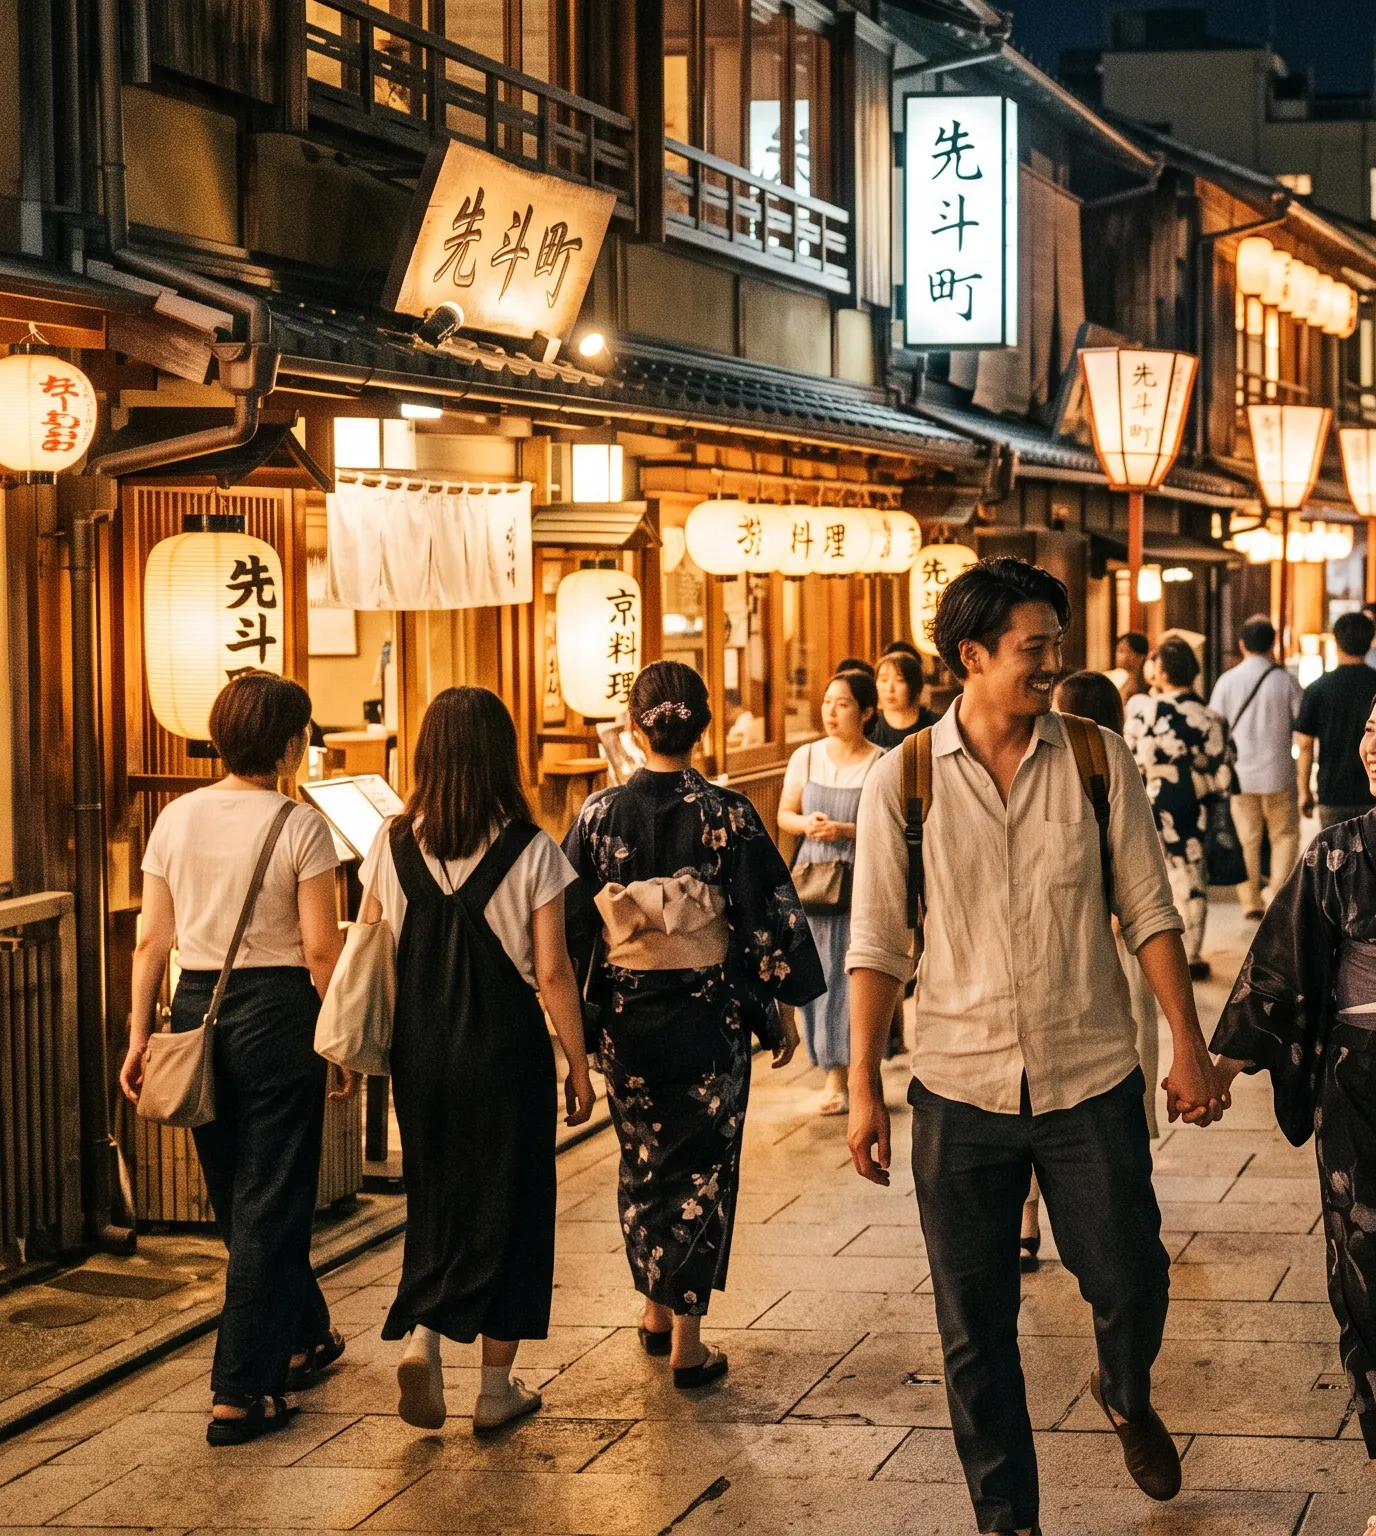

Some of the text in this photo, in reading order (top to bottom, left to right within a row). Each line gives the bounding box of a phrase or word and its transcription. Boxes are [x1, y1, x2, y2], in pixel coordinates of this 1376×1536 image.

[433, 186, 583, 308] 先斗町
[928, 119, 983, 322] 先斗町
[1131, 362, 1157, 447] 先斗町
[225, 555, 278, 682] 先斗
[606, 588, 637, 704] 京料理
